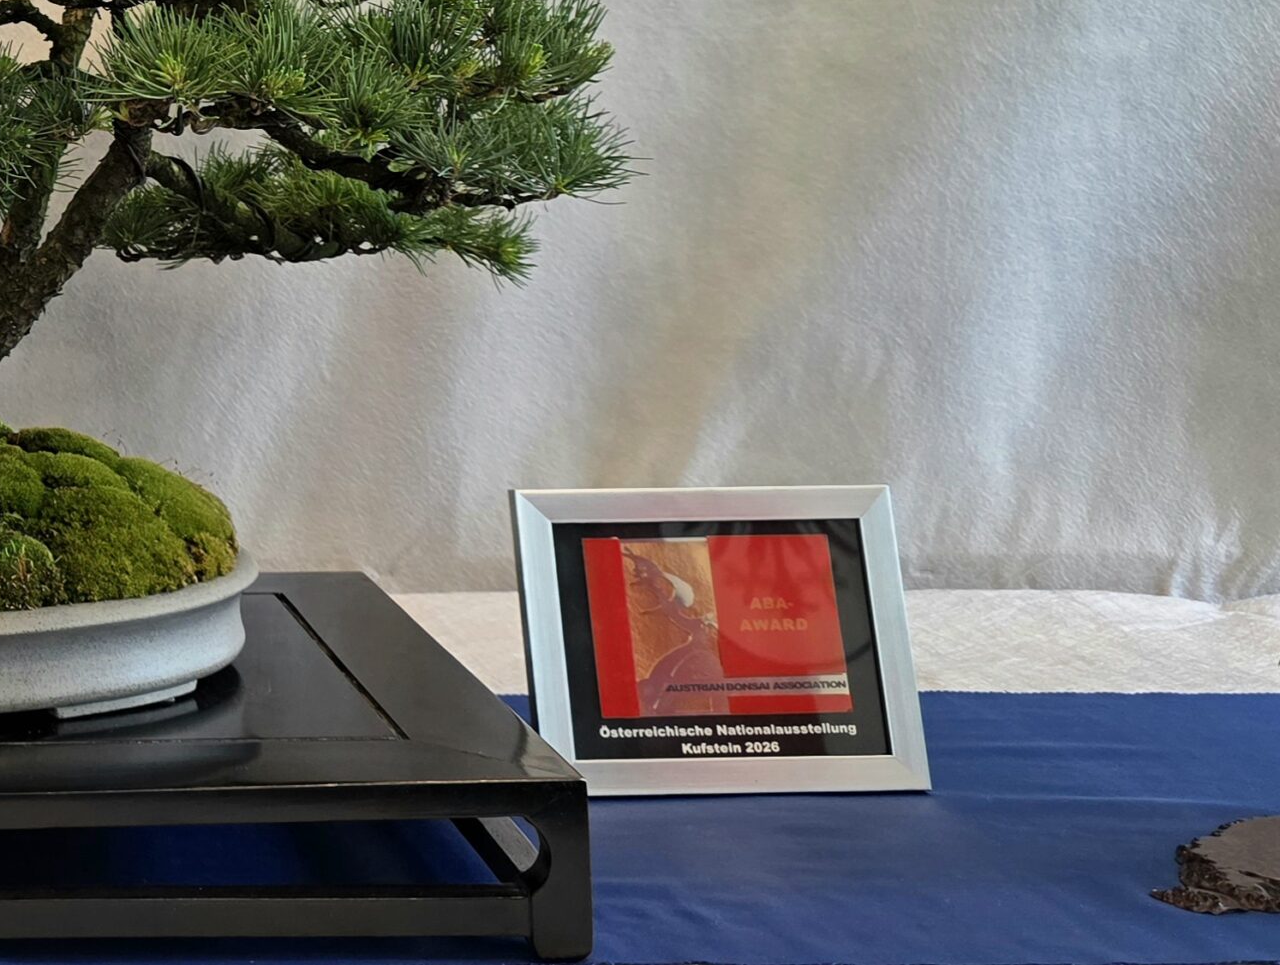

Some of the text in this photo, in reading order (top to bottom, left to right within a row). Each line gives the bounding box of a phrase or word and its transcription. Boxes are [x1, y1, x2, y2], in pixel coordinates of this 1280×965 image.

[750, 597, 793, 610] ABA-
[740, 618, 808, 632] AWARD
[666, 681, 847, 693] AUSTRIAN BONSAI ASSOCIATION
[599, 722, 857, 739] Österreichische Nationalausstellung
[682, 741, 780, 755] Kufstein 2026
